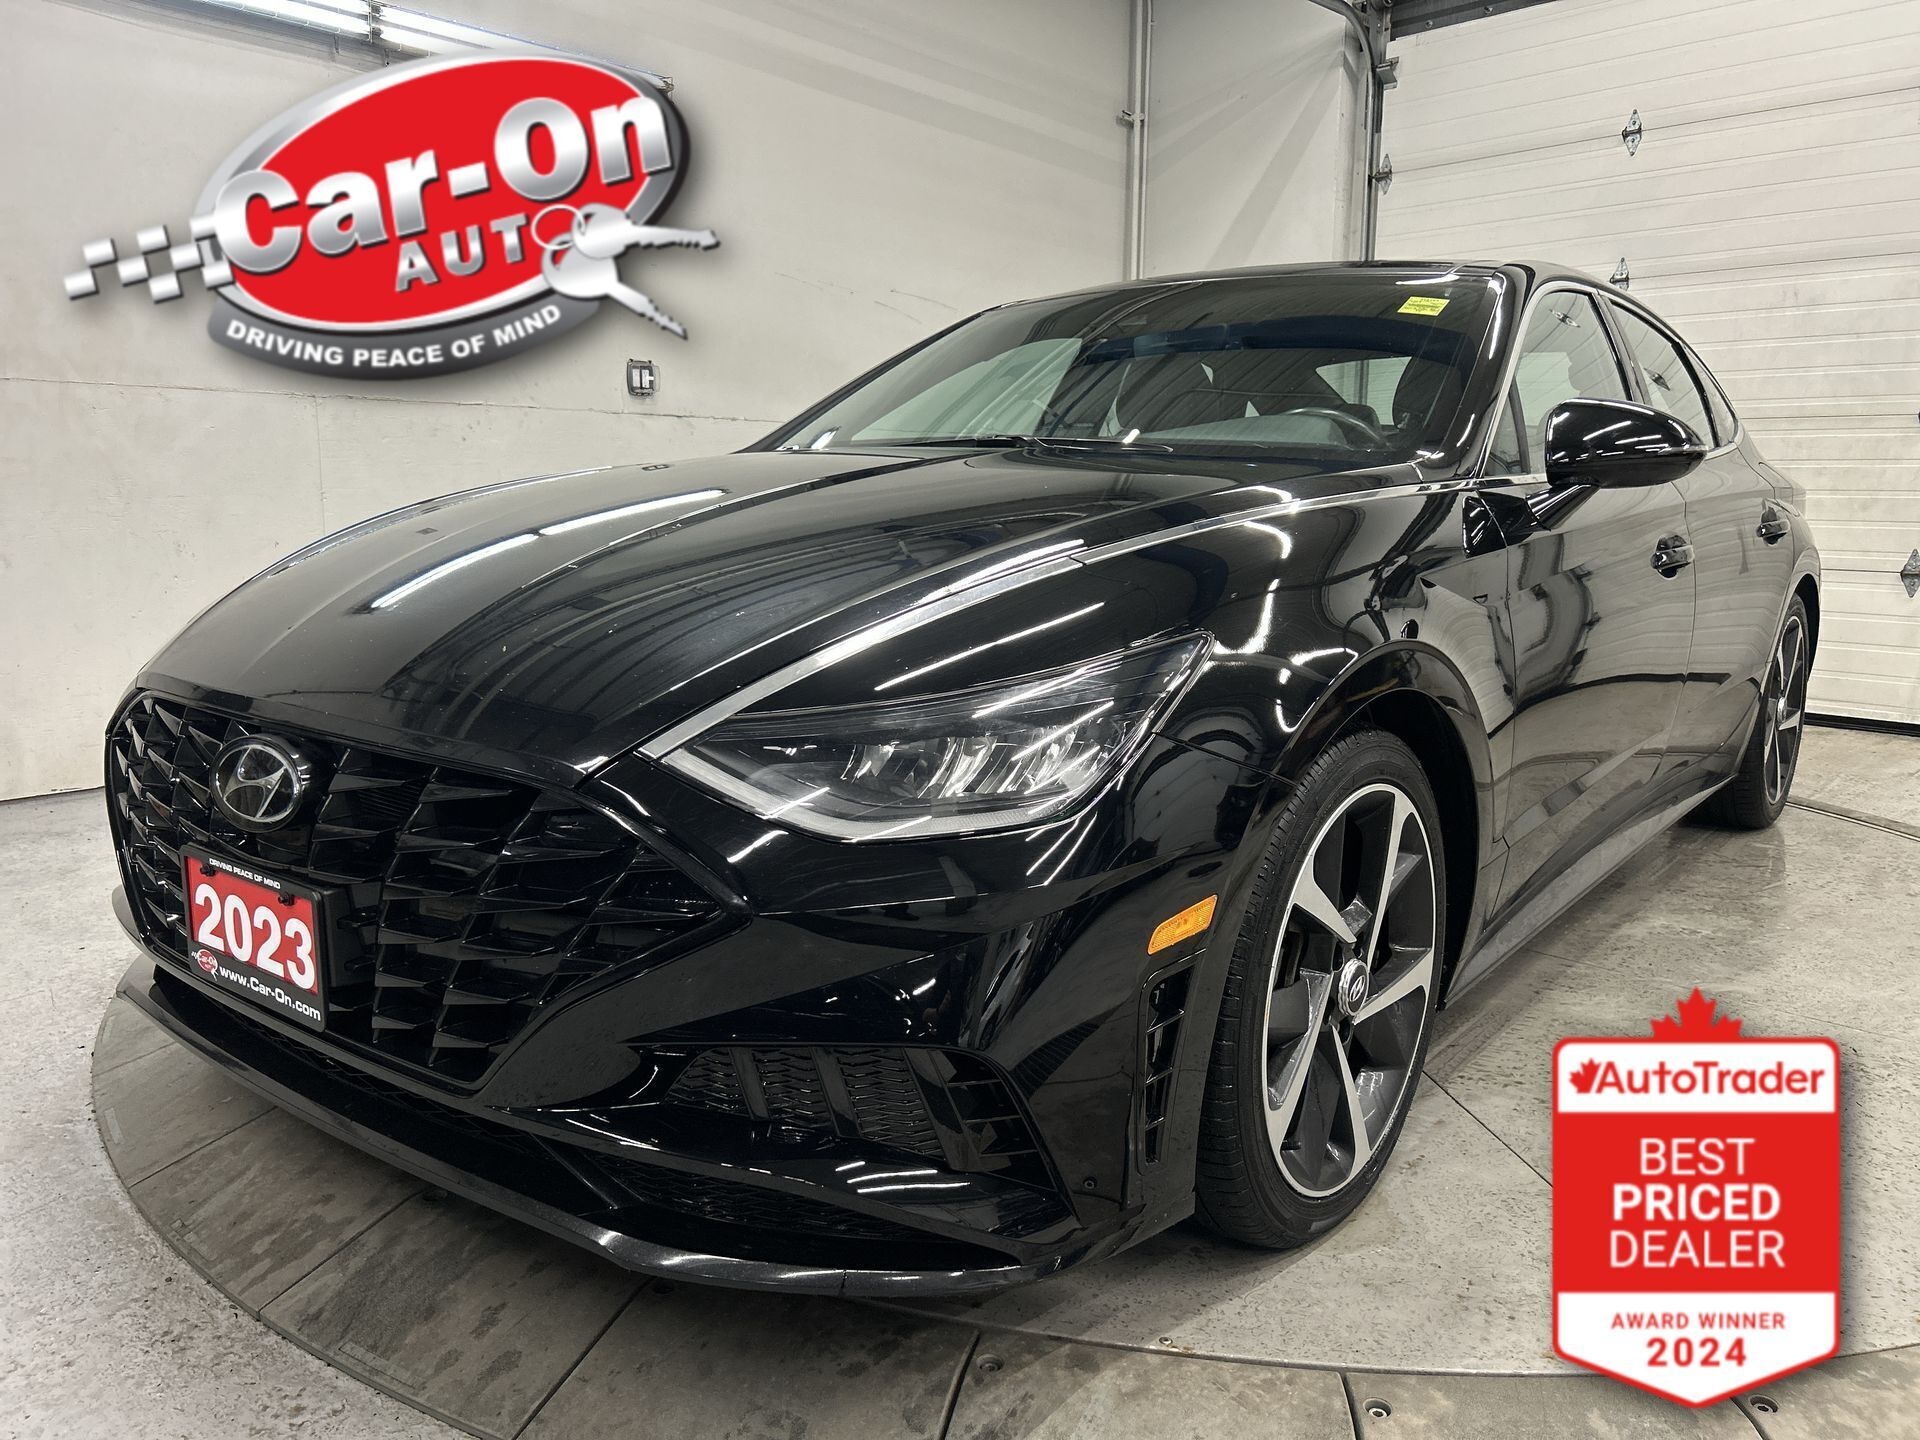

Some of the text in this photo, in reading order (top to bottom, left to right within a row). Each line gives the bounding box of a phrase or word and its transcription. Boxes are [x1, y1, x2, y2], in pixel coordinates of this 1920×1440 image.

[209, 858, 280, 889] DRIVING PEACE OF MIND
[195, 883, 315, 990] 2023
[219, 966, 321, 1021] www.Car-On.com
